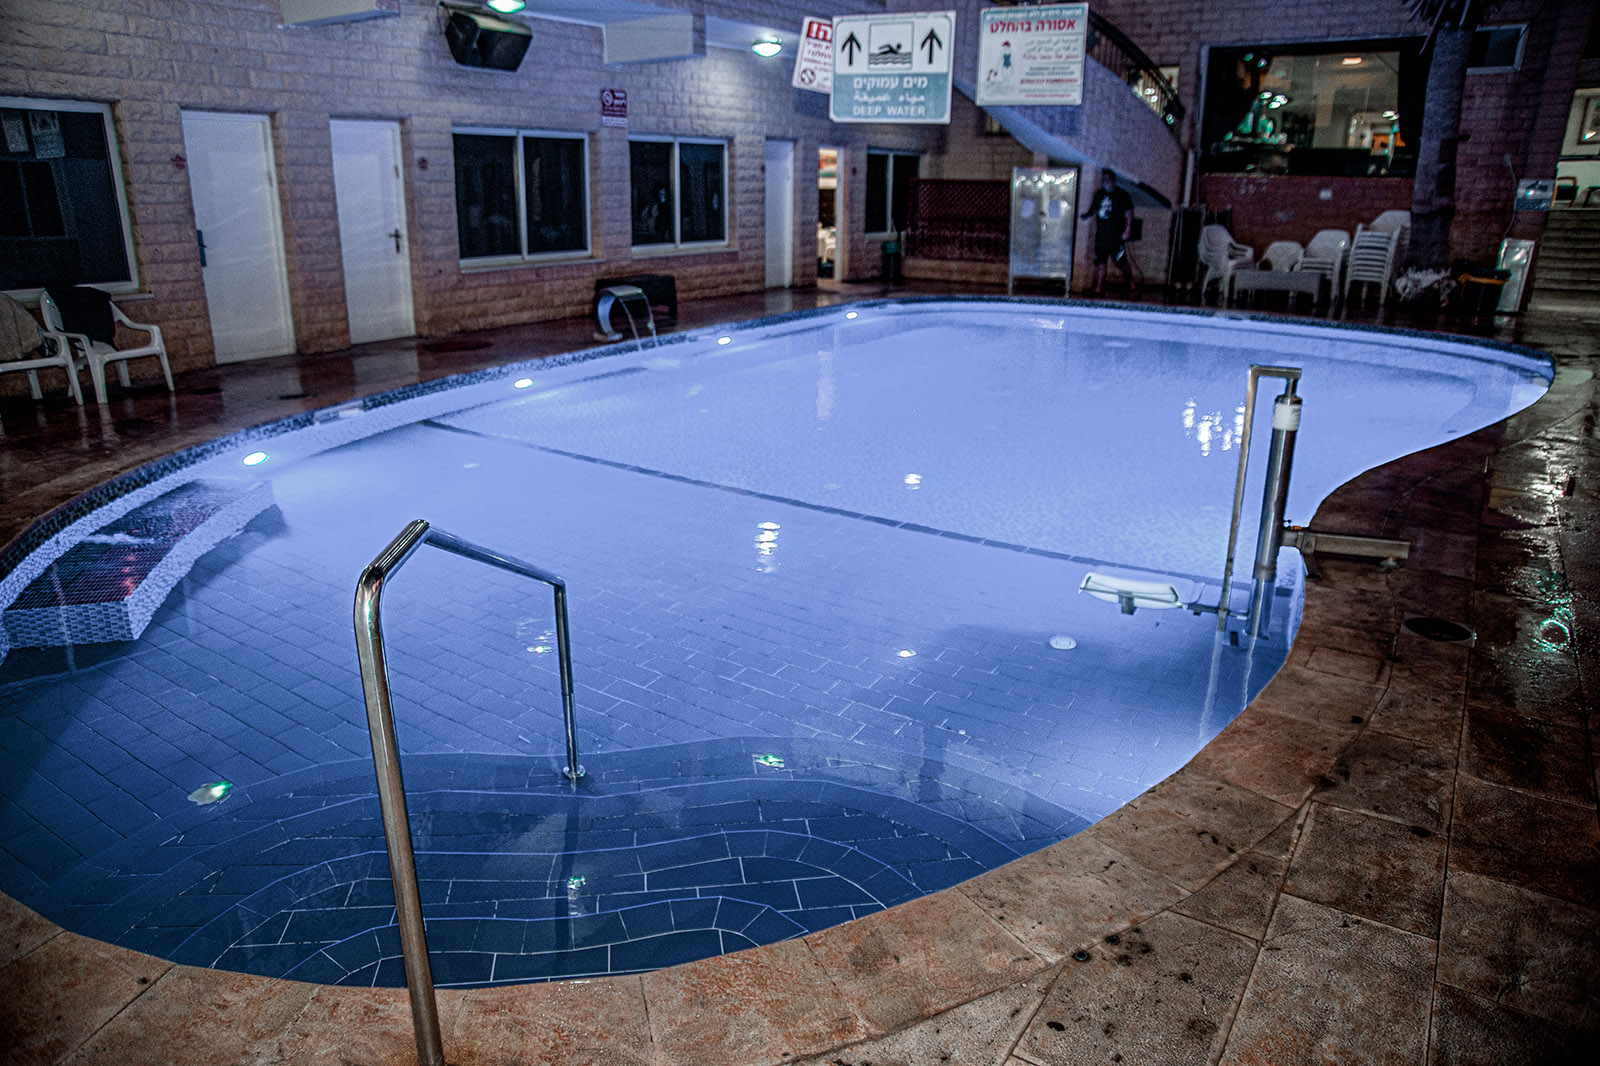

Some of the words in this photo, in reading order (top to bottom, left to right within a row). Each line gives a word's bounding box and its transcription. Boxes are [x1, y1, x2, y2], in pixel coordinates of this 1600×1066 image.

[990, 20, 1032, 34] בהחלט
[1036, 19, 1076, 31] אסורה
[853, 76, 899, 91] עמוקים
[903, 76, 928, 89] מים
[853, 89, 891, 103] عميقة
[899, 91, 925, 103] مياه
[852, 105, 882, 116] DEEP
[886, 105, 926, 116] WATER
